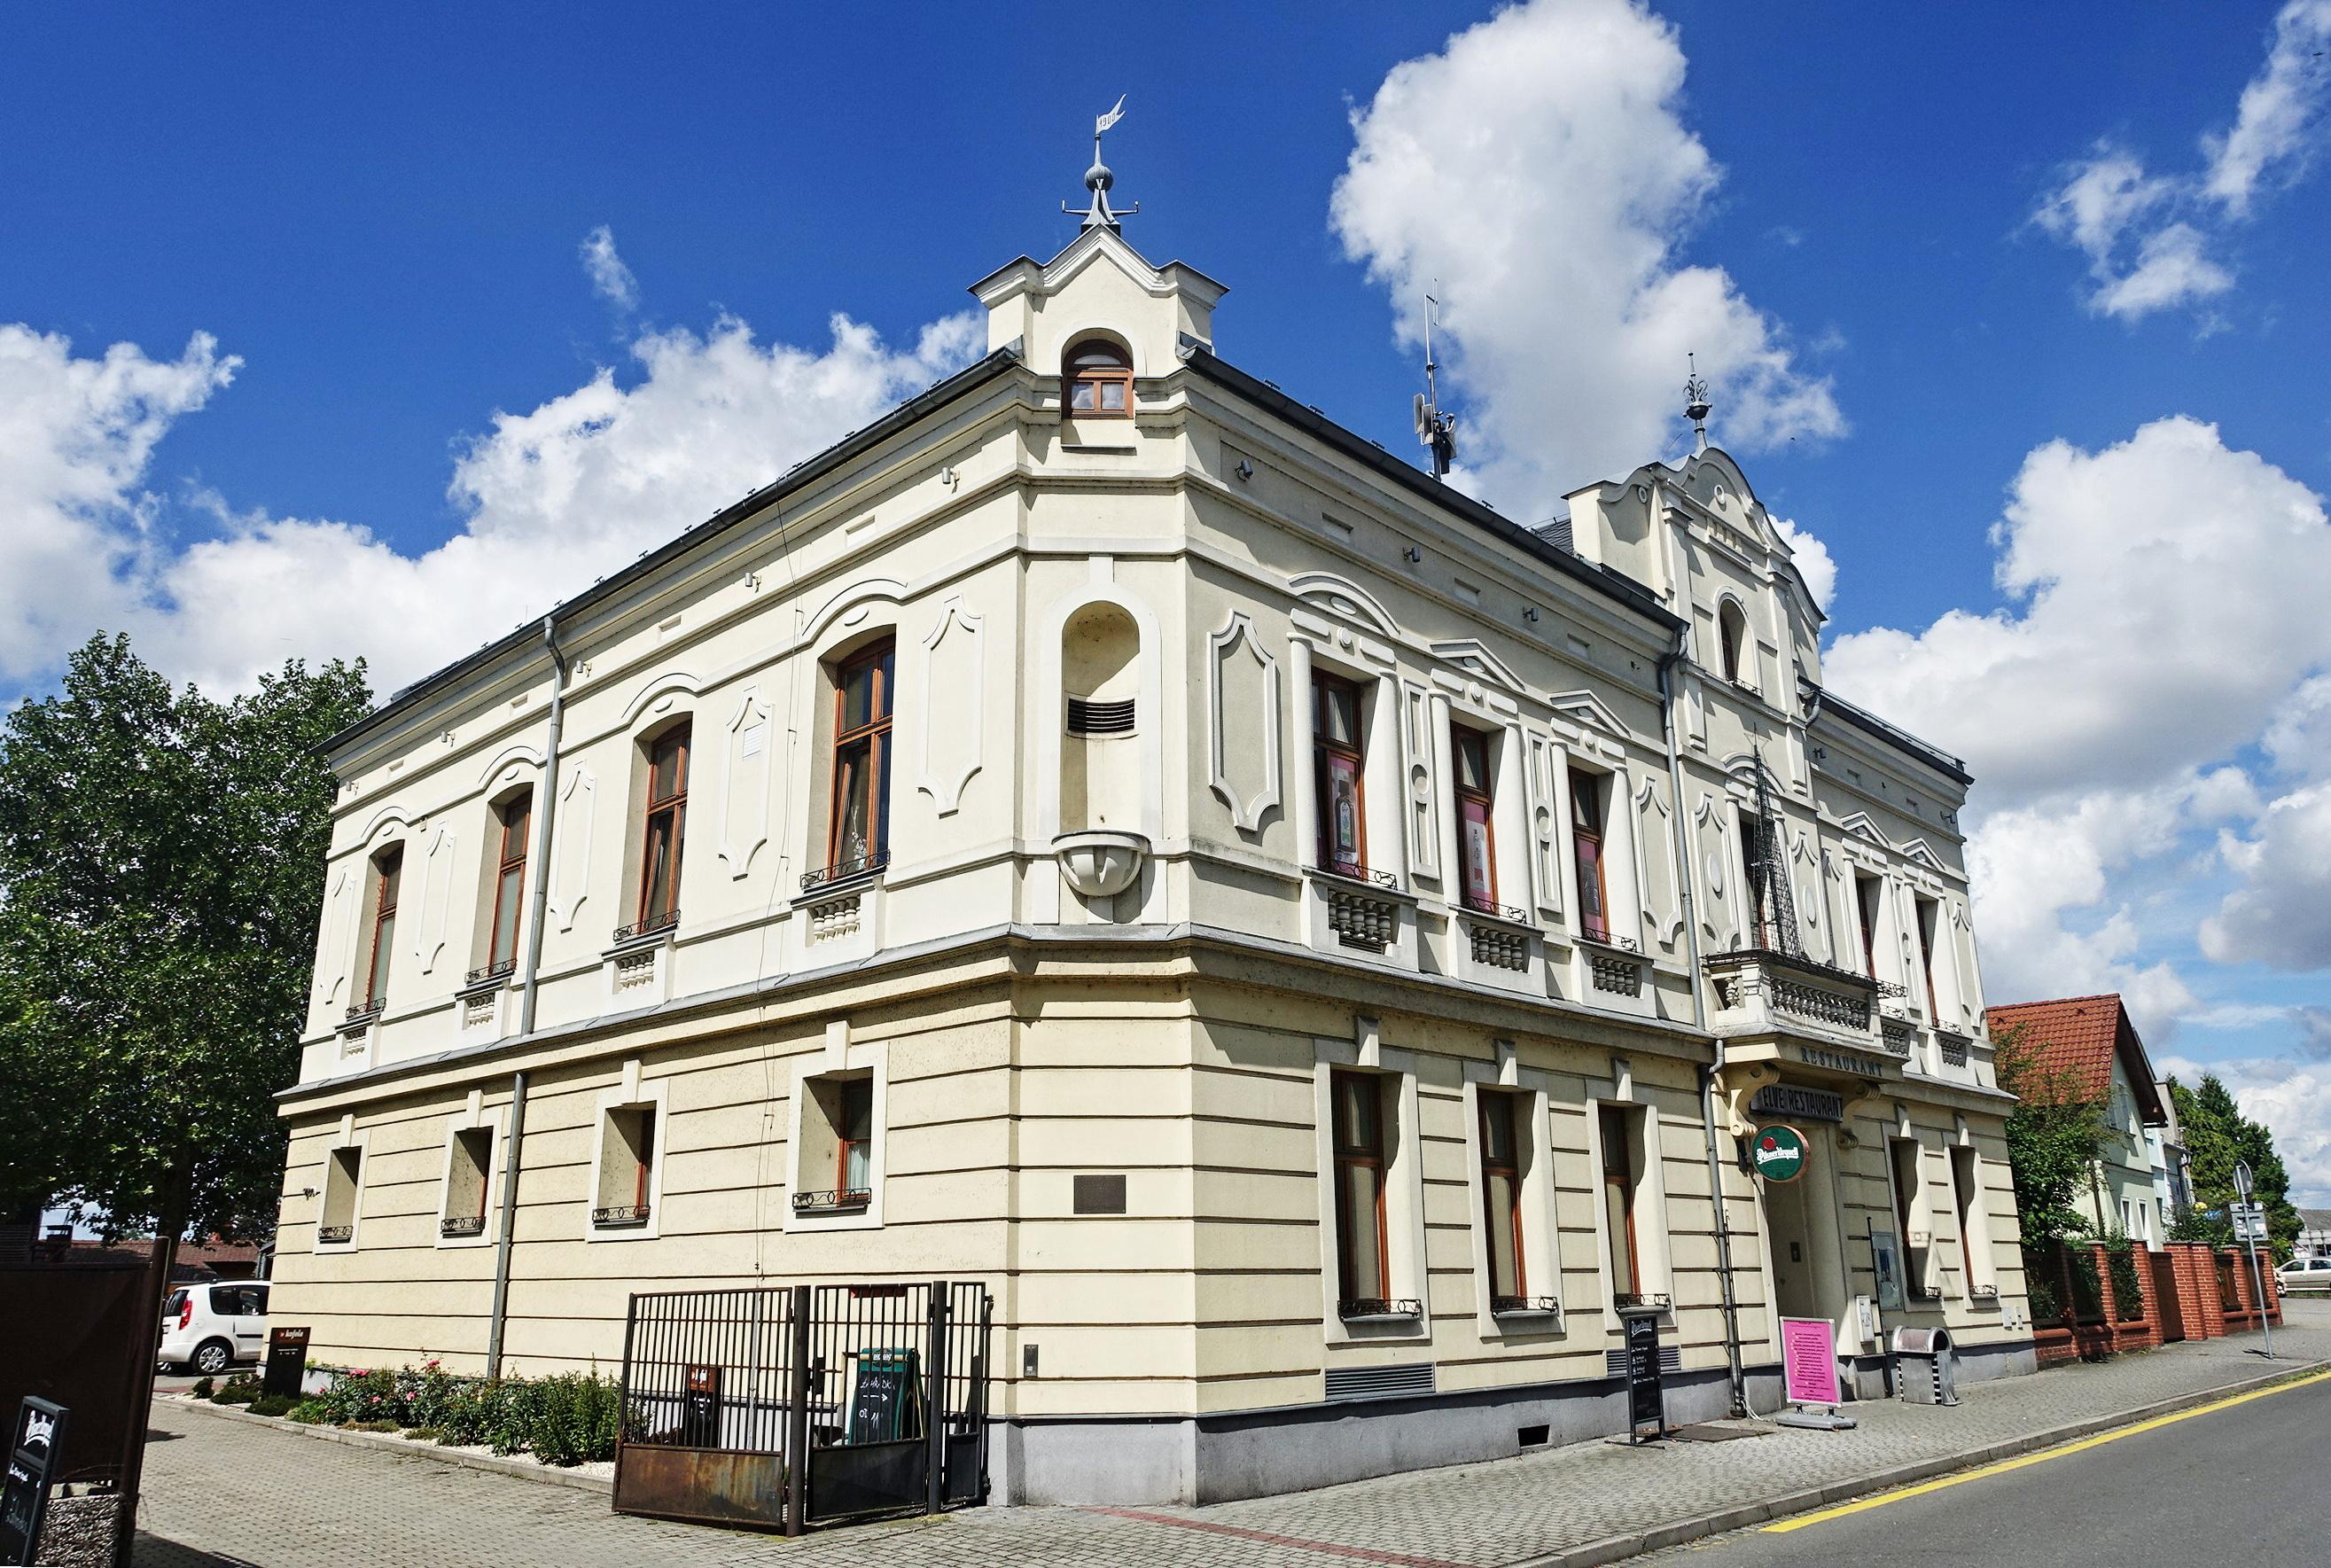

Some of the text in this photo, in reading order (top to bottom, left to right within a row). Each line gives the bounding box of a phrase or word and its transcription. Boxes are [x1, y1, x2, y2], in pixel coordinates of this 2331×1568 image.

[1099, 113, 1116, 127] 1900
[1801, 1047, 1883, 1077] RESTAURANT
[1787, 1089, 1844, 1117] RESTAURANT
